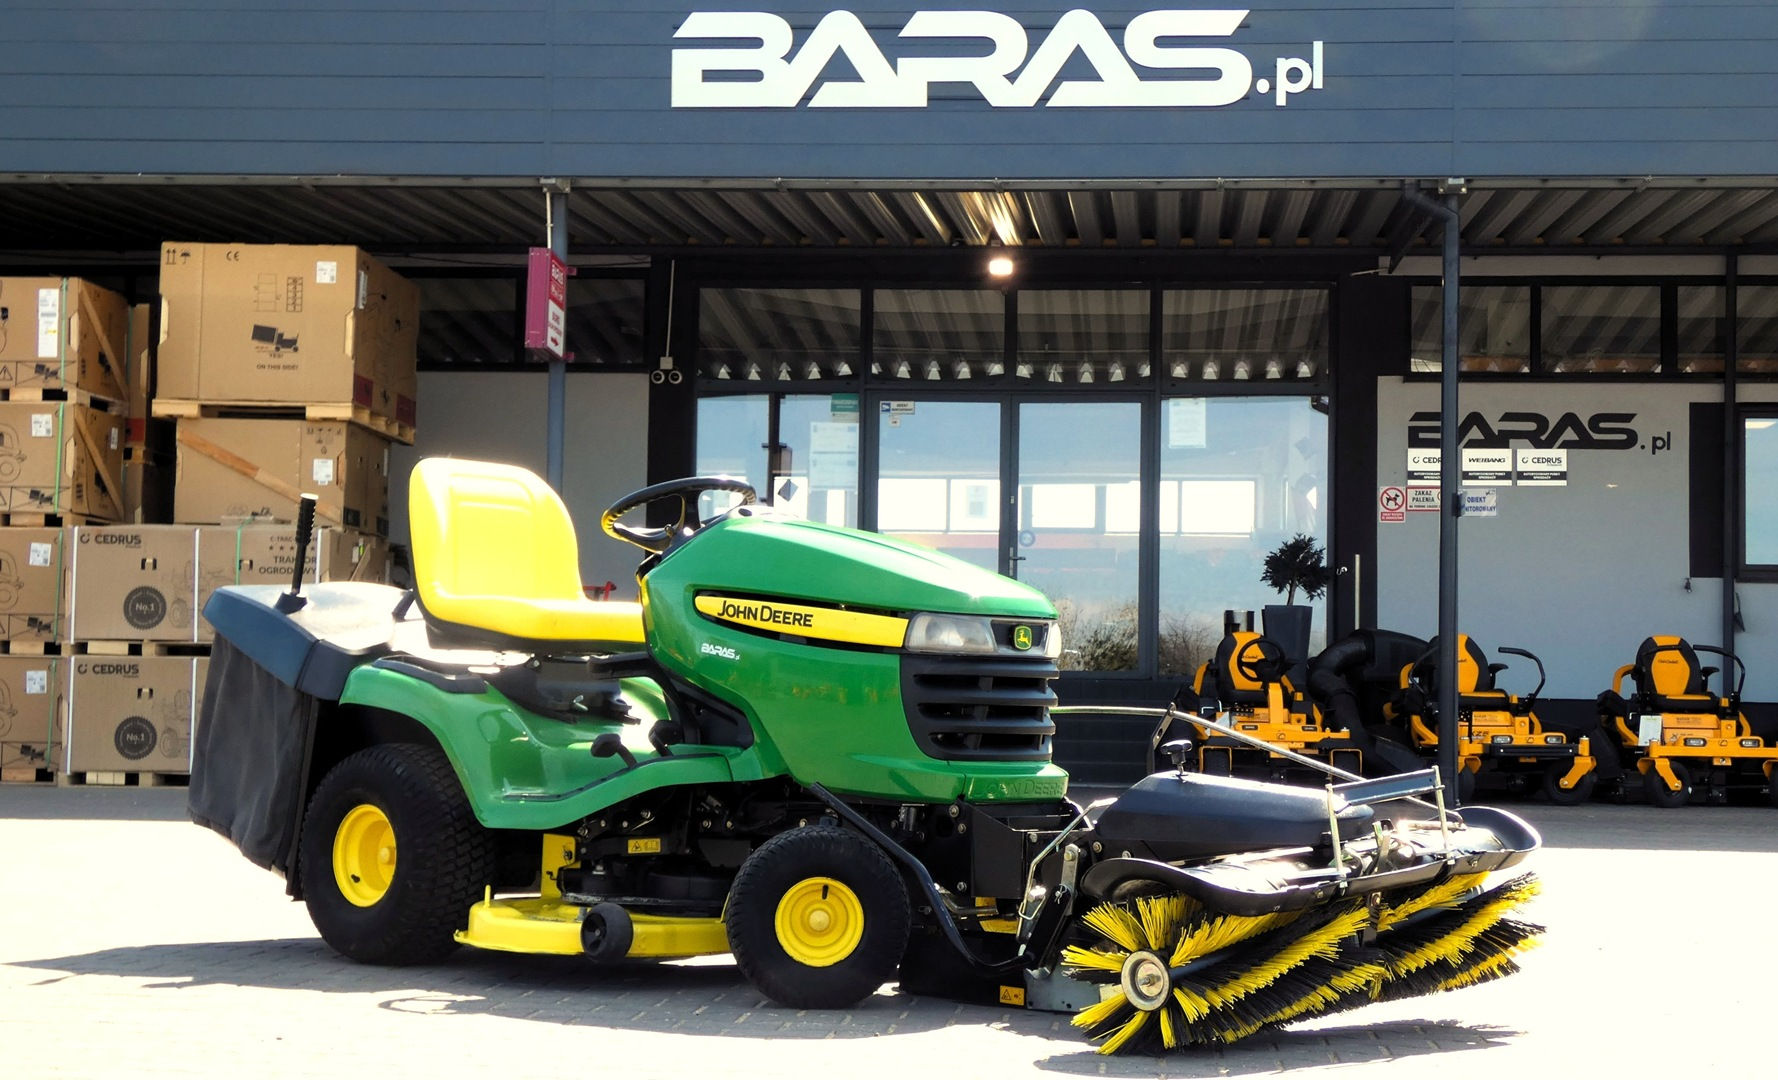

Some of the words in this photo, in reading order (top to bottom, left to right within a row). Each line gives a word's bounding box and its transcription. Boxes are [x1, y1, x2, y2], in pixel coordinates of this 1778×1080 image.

[671, 9, 1323, 108] BARAS.pl
[94, 534, 142, 545] CEDRUS
[717, 600, 759, 621] JOHN
[759, 604, 814, 628] DEERE
[92, 663, 140, 675] CEDRUS
